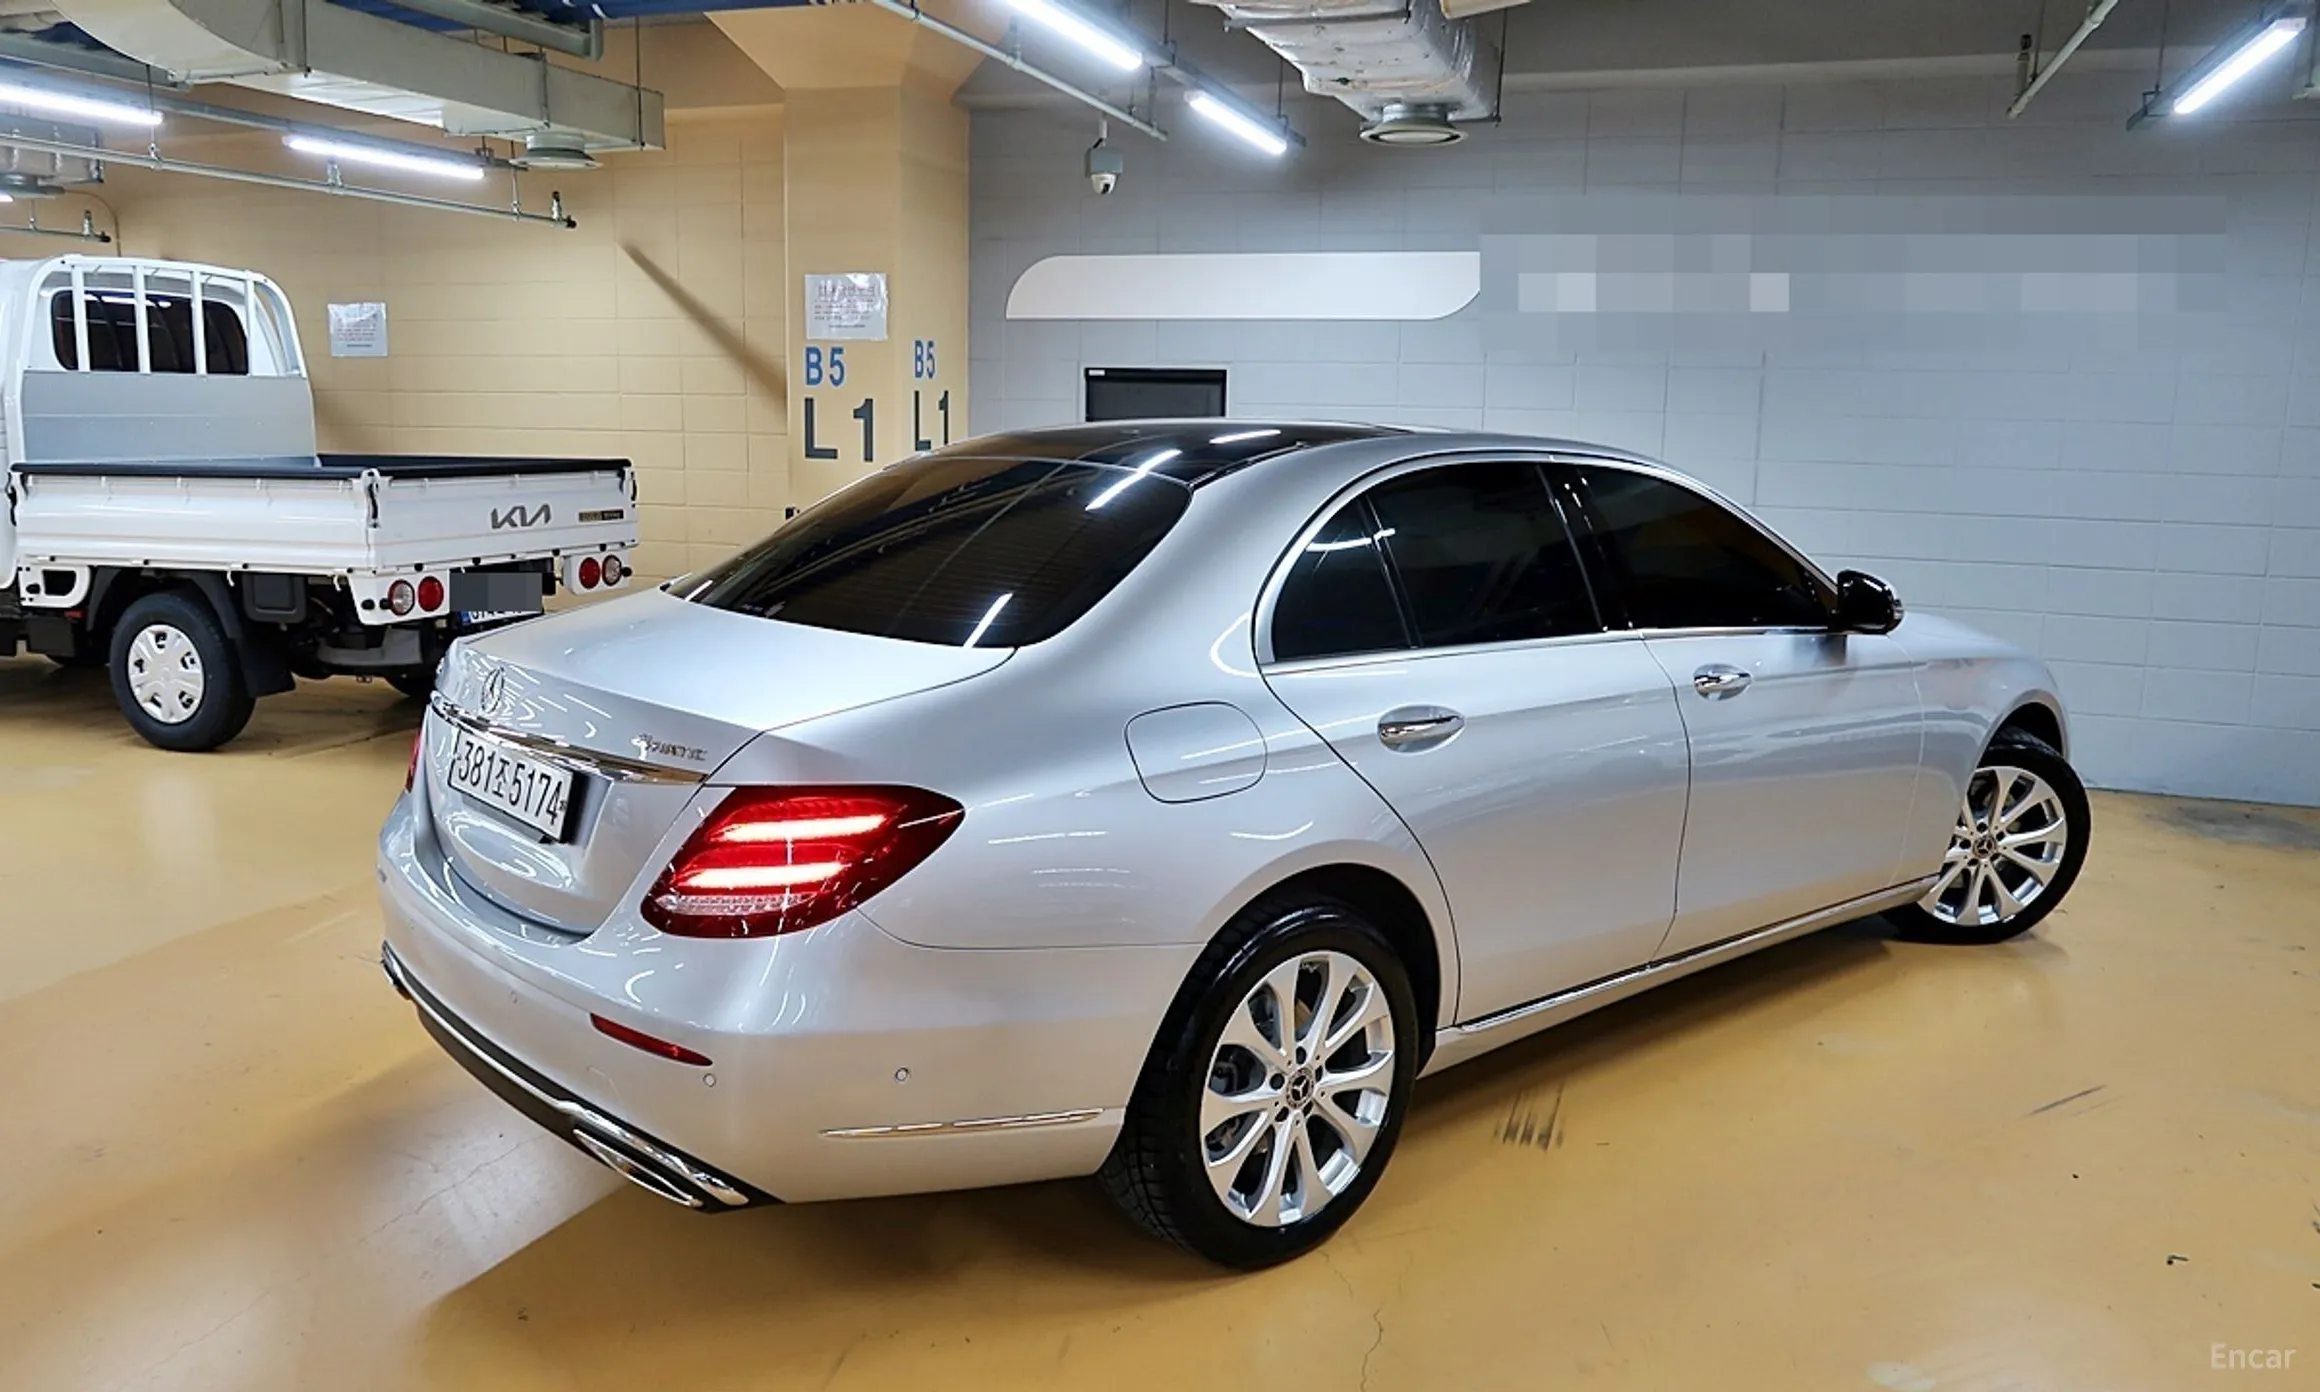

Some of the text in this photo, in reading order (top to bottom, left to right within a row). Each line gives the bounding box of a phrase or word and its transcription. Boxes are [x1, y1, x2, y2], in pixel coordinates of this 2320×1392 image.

[805, 347, 845, 386] B5
[914, 340, 936, 379] B5
[805, 397, 873, 462] L1
[914, 390, 949, 451] L1
